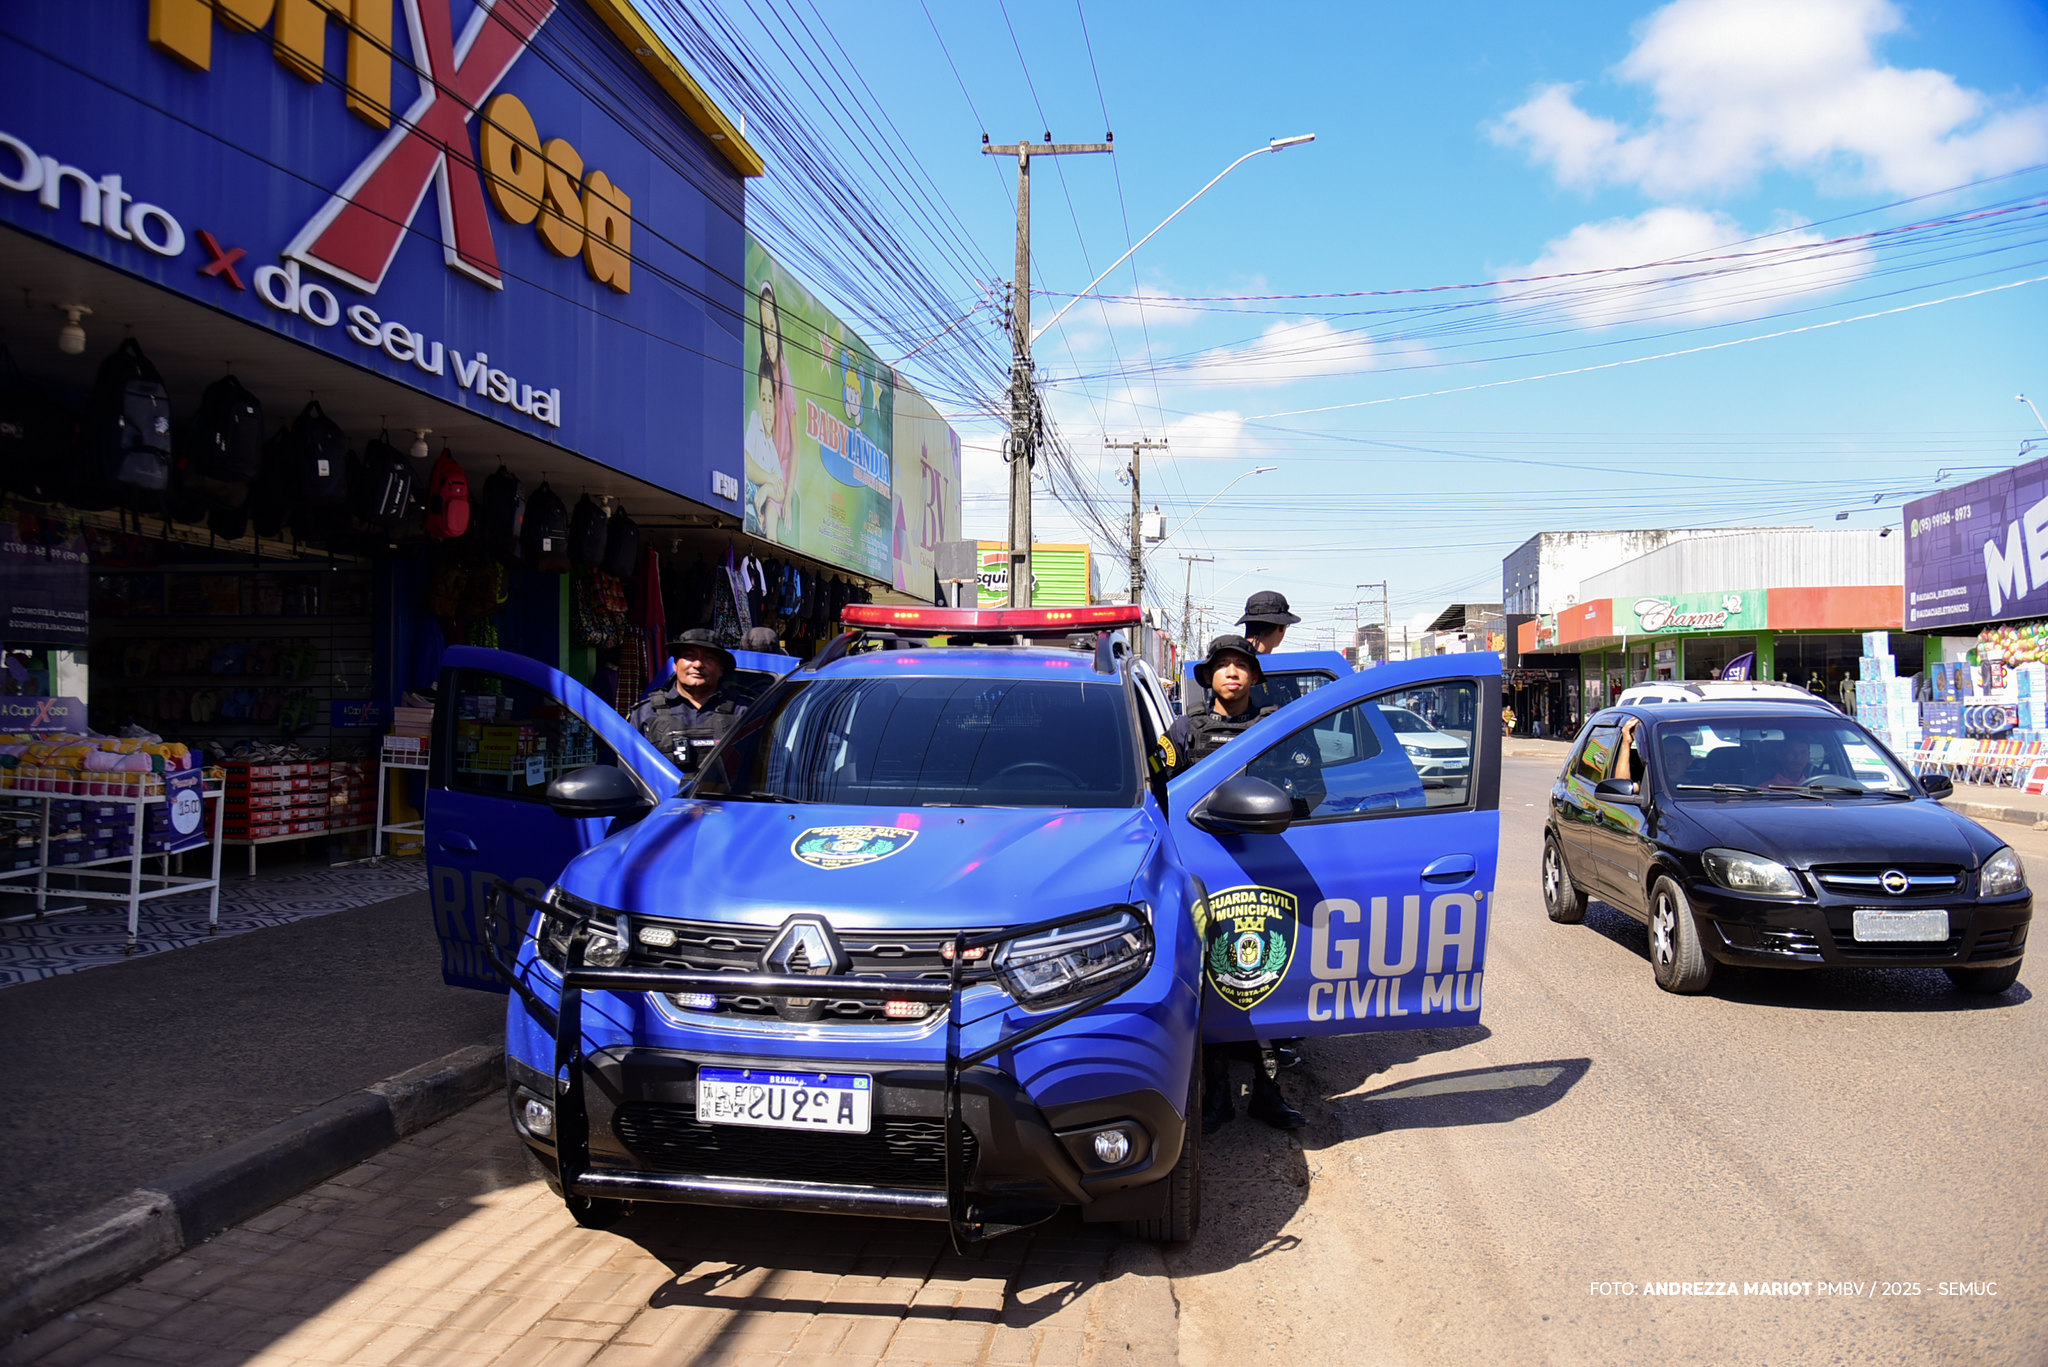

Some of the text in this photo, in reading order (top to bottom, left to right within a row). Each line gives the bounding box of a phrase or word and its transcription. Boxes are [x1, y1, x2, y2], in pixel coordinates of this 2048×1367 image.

[254, 258, 340, 327] do
[346, 303, 444, 375] seu
[448, 349, 561, 427] visual
[1919, 517, 1932, 534] (95)
[1932, 511, 1950, 528] 99156
[1955, 505, 1972, 522] 8973
[1634, 598, 1728, 632] Charme
[1210, 891, 1292, 911] GUARDA CIVIL
[1216, 904, 1283, 922] MUNICIPAL
[1310, 891, 1494, 980] GUA
[1221, 985, 1234, 995] BOA
[1308, 976, 1409, 1021] CIVIL
